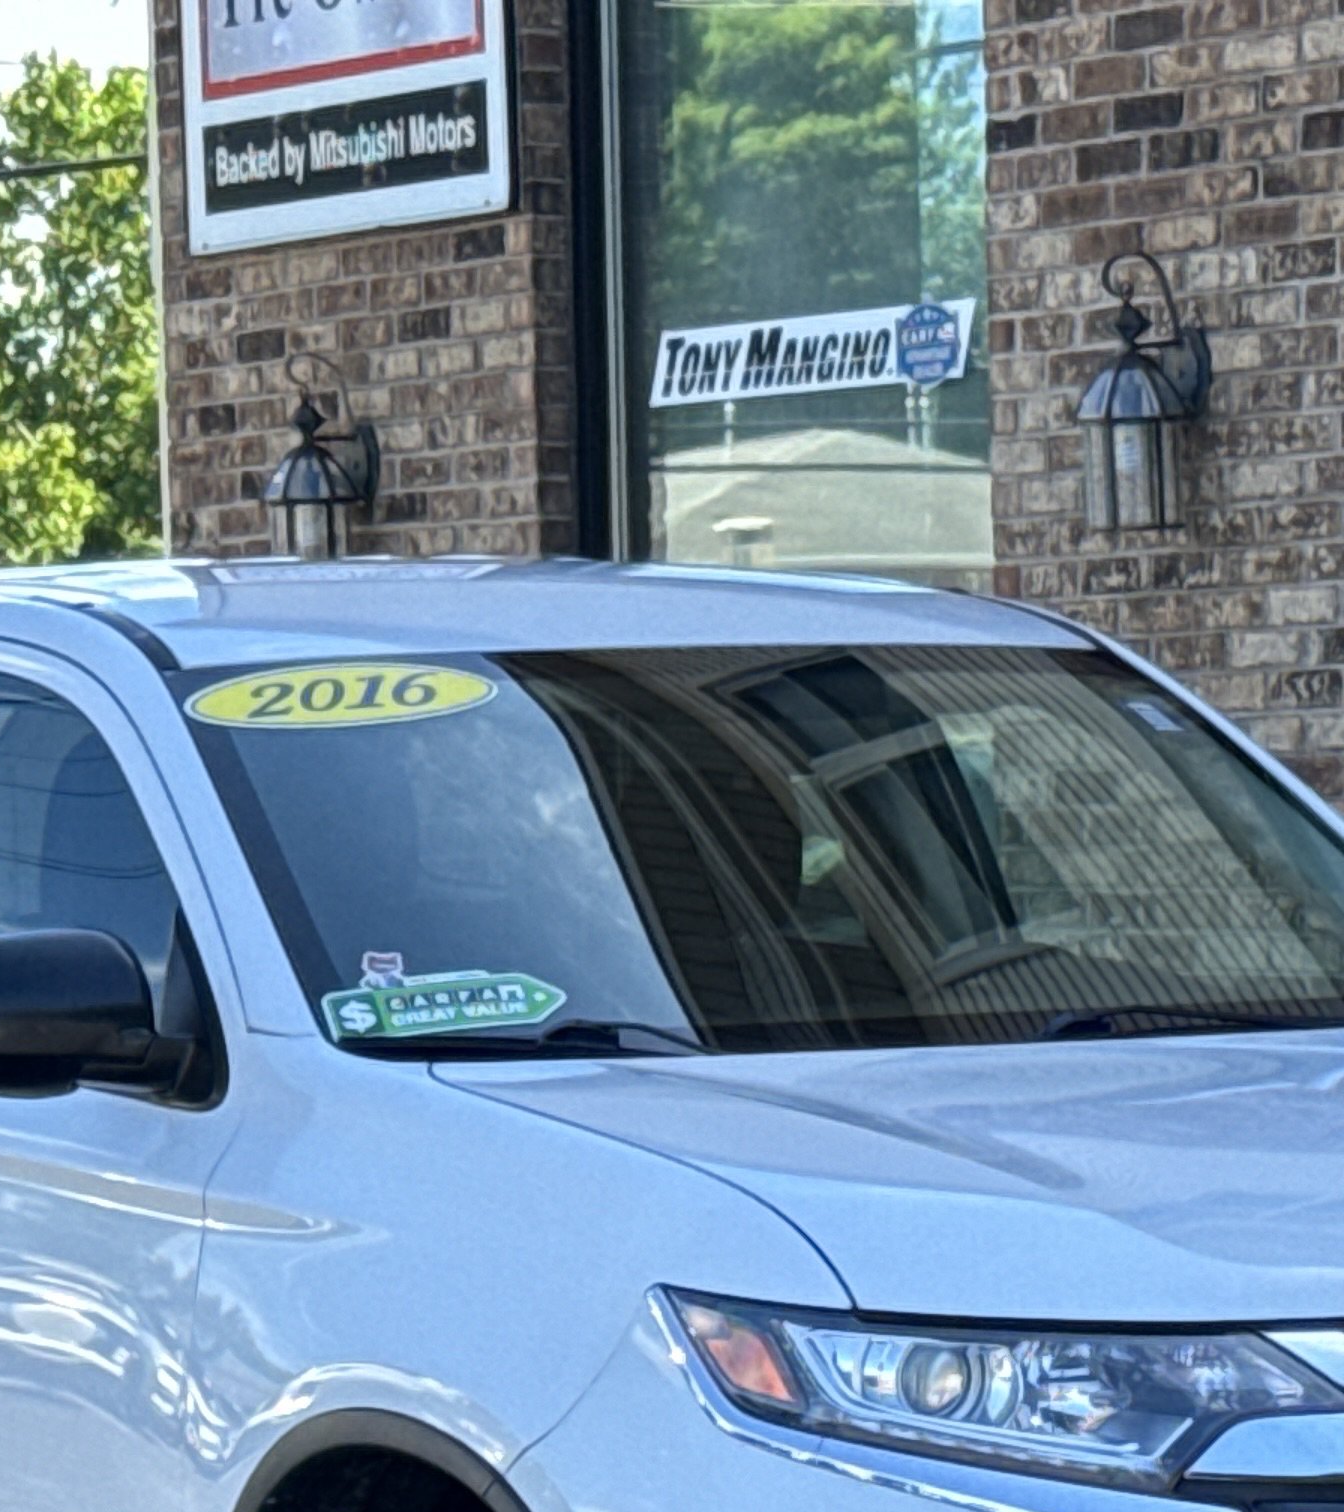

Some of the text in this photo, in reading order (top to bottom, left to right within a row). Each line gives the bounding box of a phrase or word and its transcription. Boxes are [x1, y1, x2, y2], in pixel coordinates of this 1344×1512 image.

[215, 112, 476, 187] Backed by Mitsubishi Motors
[661, 336, 743, 398] TONY
[246, 671, 443, 719] 2016
